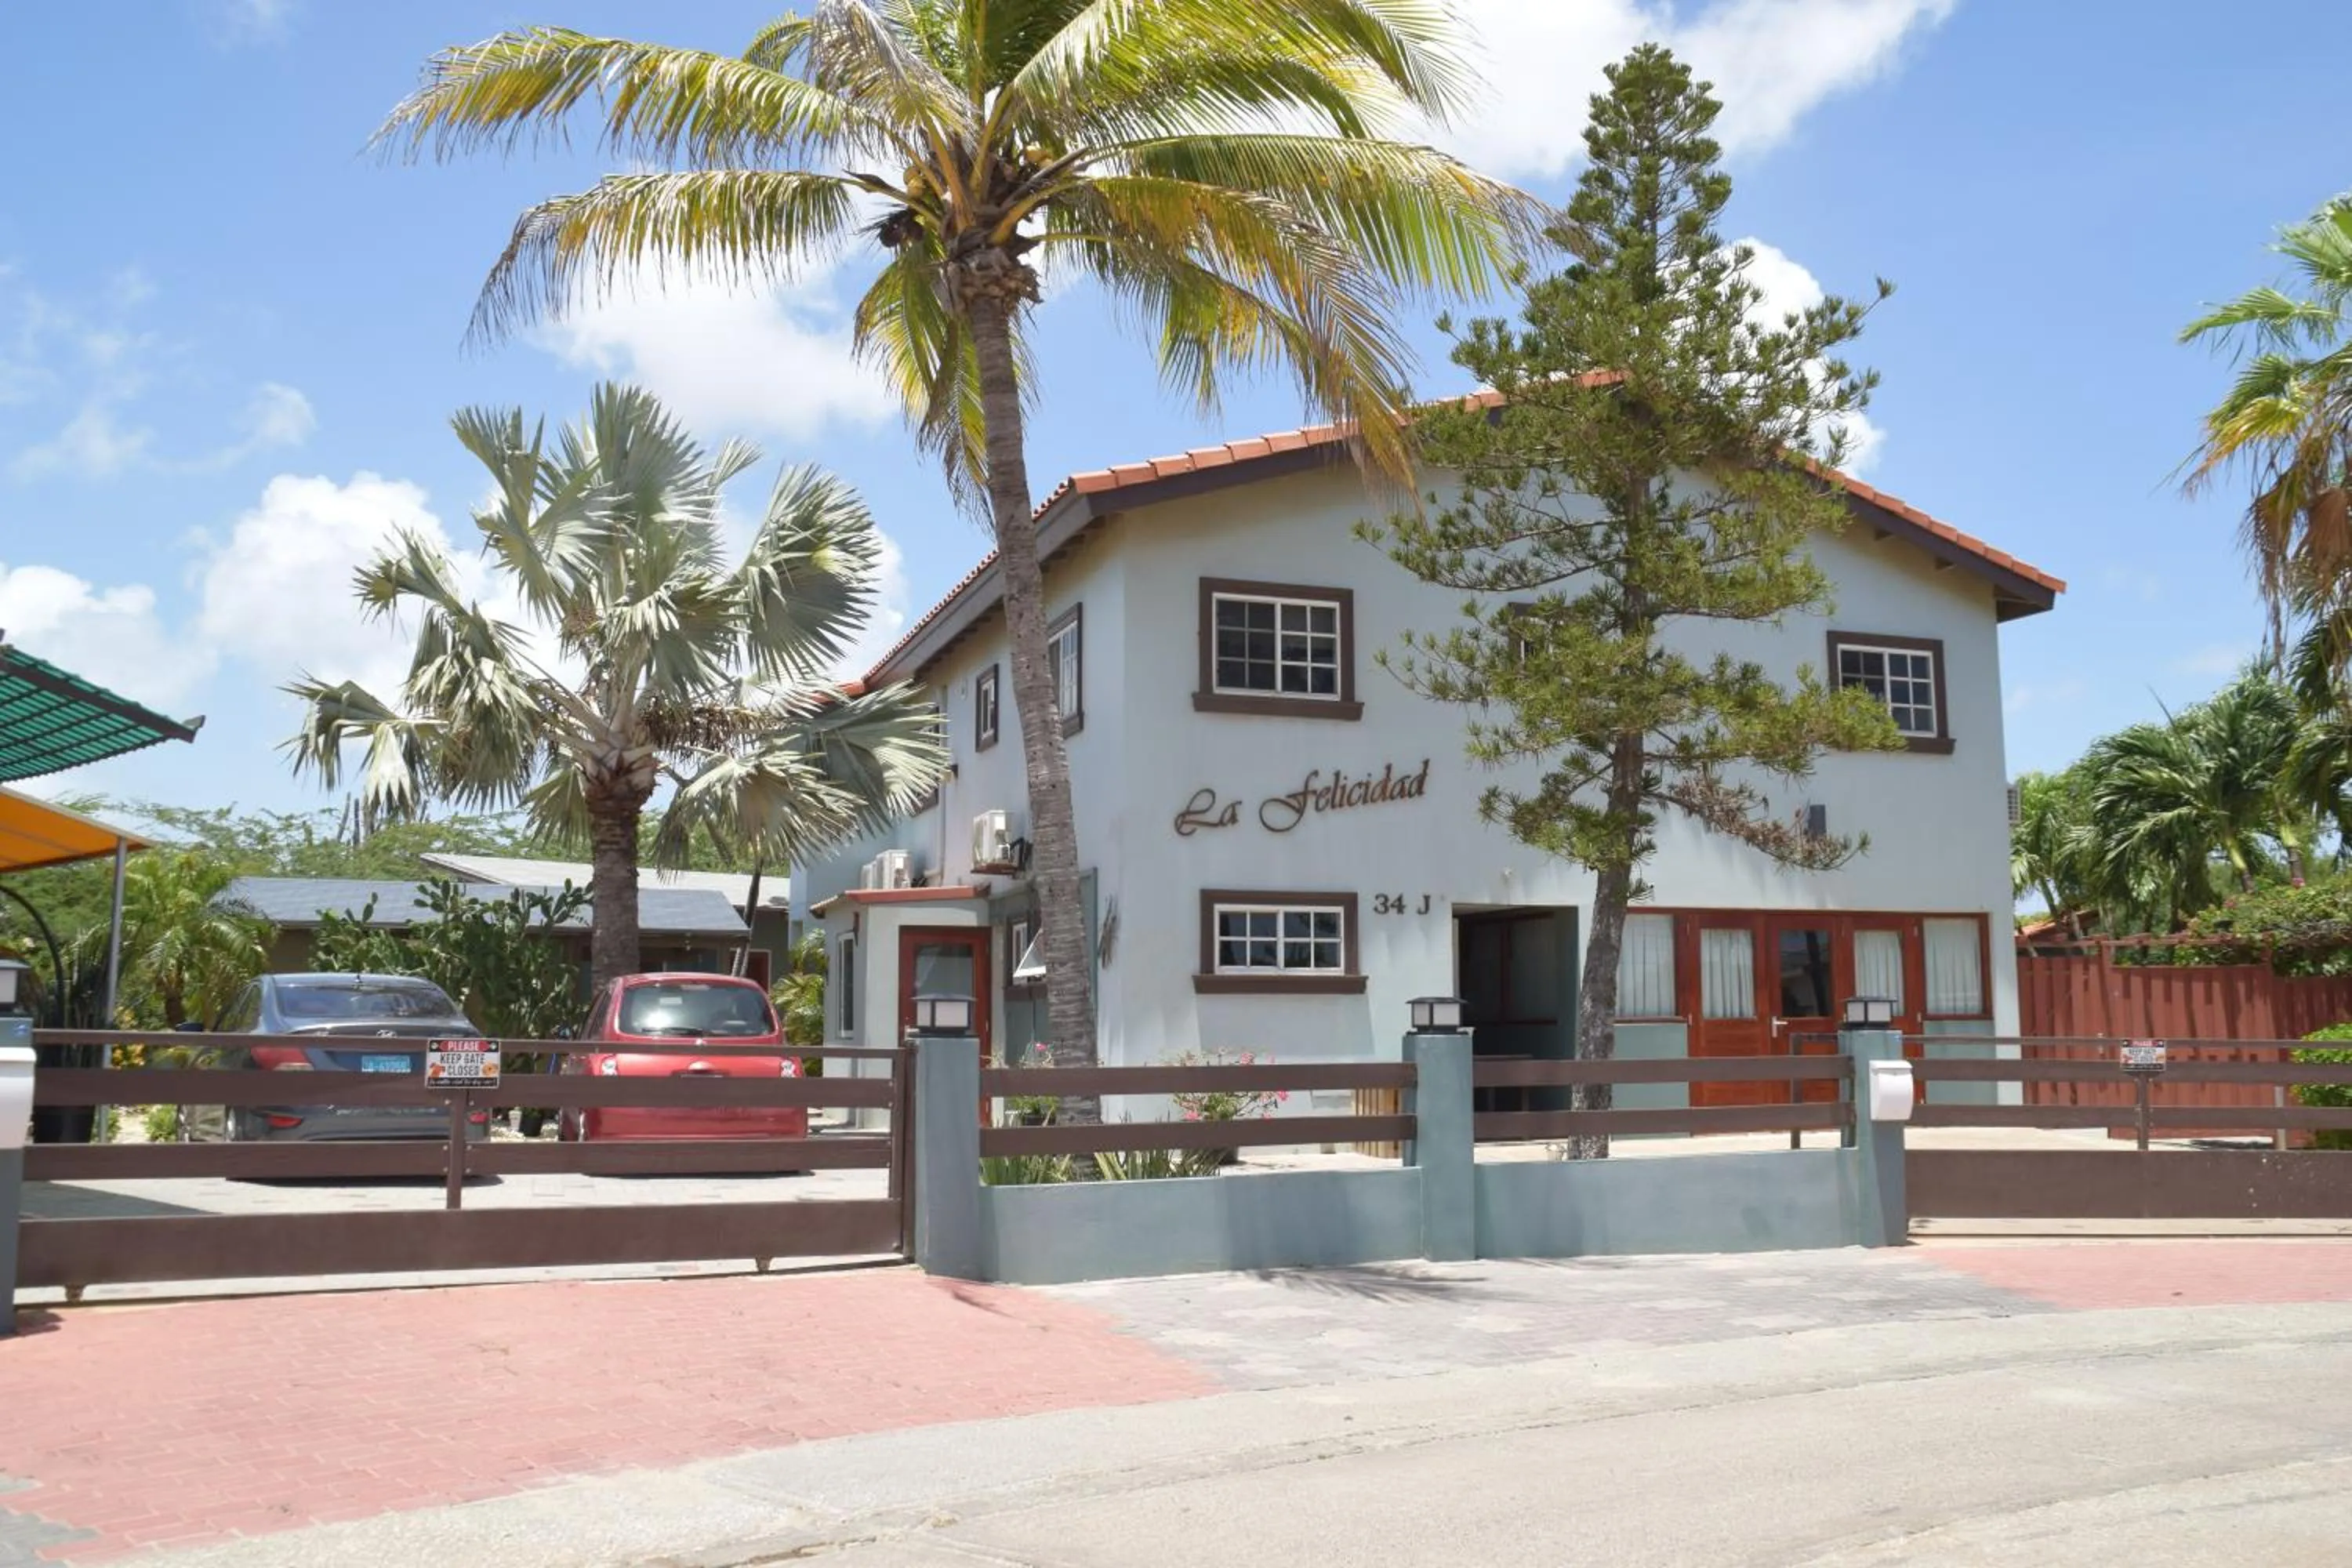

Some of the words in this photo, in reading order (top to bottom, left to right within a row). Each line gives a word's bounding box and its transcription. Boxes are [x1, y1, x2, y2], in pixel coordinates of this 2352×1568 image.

[1174, 788, 1243, 836] La
[1259, 758, 1430, 832] Felicidad
[1374, 894, 1406, 915] 34
[1417, 895, 1432, 915] J
[448, 1040, 479, 1051] PLEASE
[440, 1053, 461, 1064] KEEP
[463, 1053, 485, 1064] GATE
[448, 1065, 479, 1076] CLOSED
